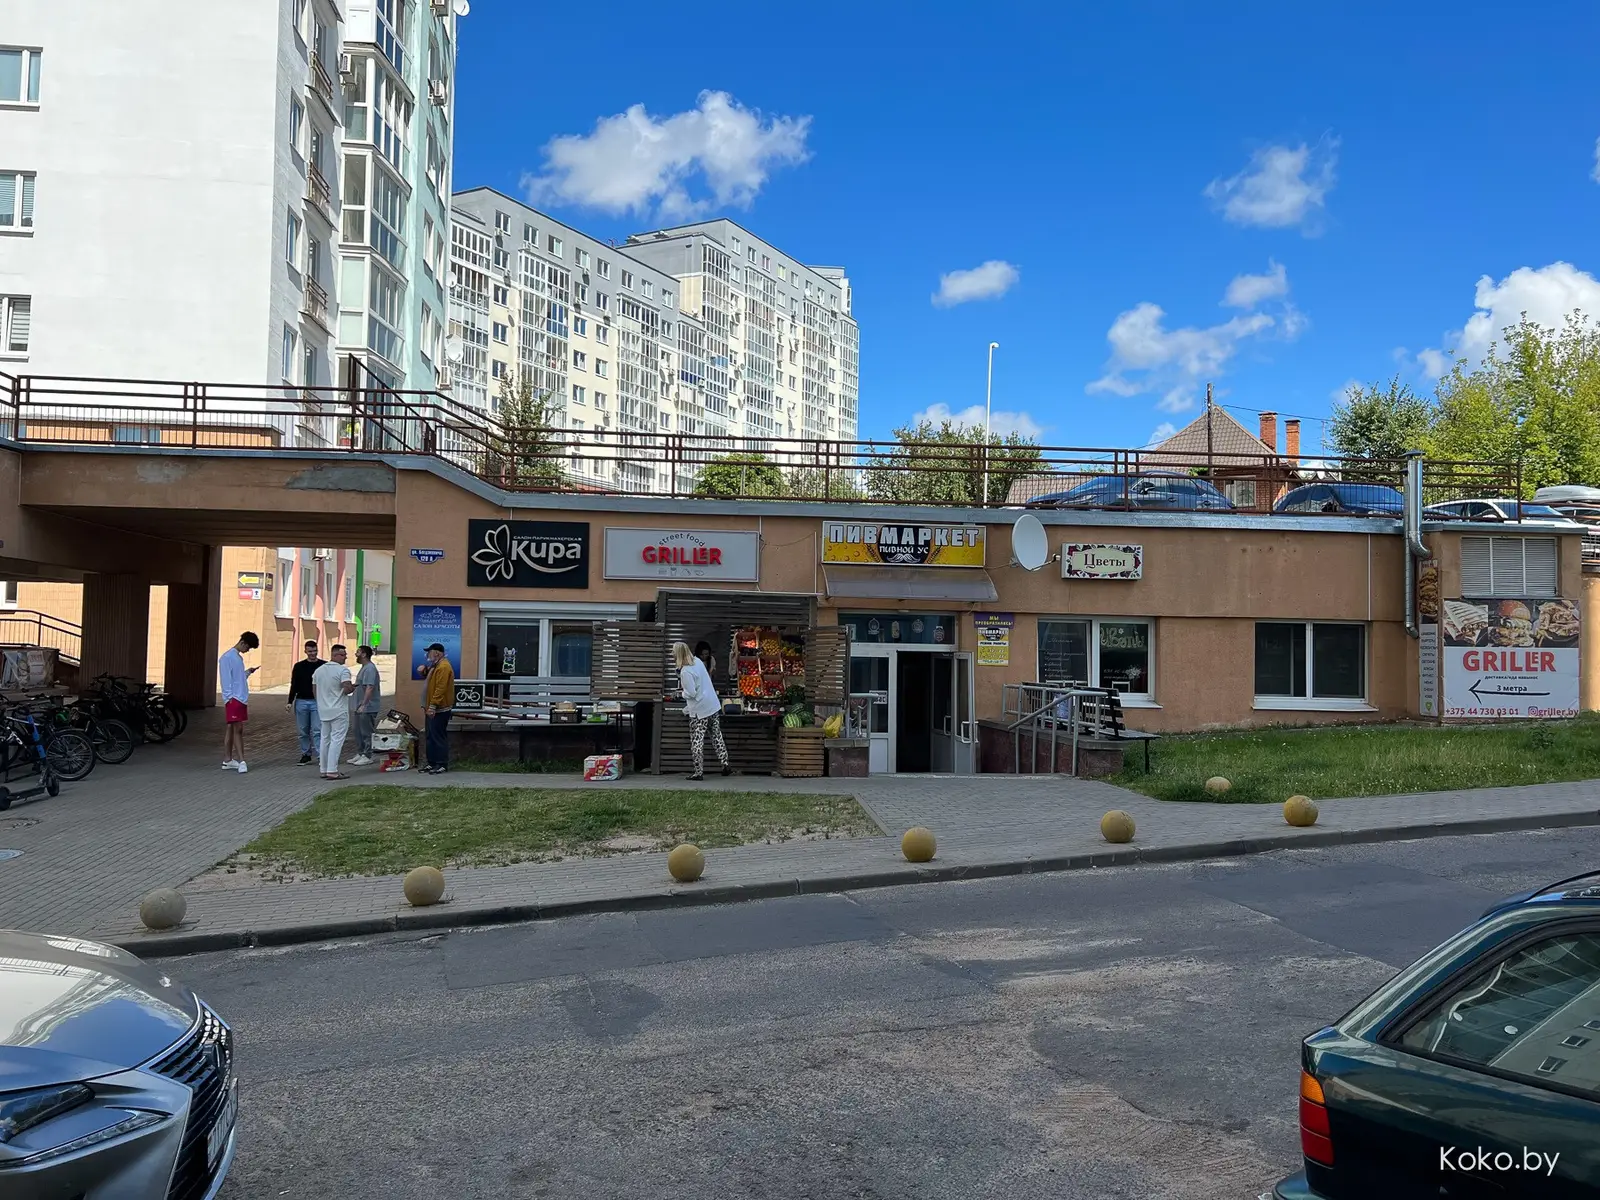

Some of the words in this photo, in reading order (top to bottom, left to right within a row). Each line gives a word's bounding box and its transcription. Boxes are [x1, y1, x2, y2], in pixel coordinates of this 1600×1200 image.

[658, 533, 683, 546] street
[686, 533, 706, 547] food
[829, 524, 980, 547] ПИВМАРКЕТ
[642, 546, 722, 565] GRILLER
[1084, 553, 1126, 569] Цветы
[1462, 650, 1557, 673] GRILLER
[1503, 685, 1527, 693] метра
[1538, 707, 1579, 717] griller.by
